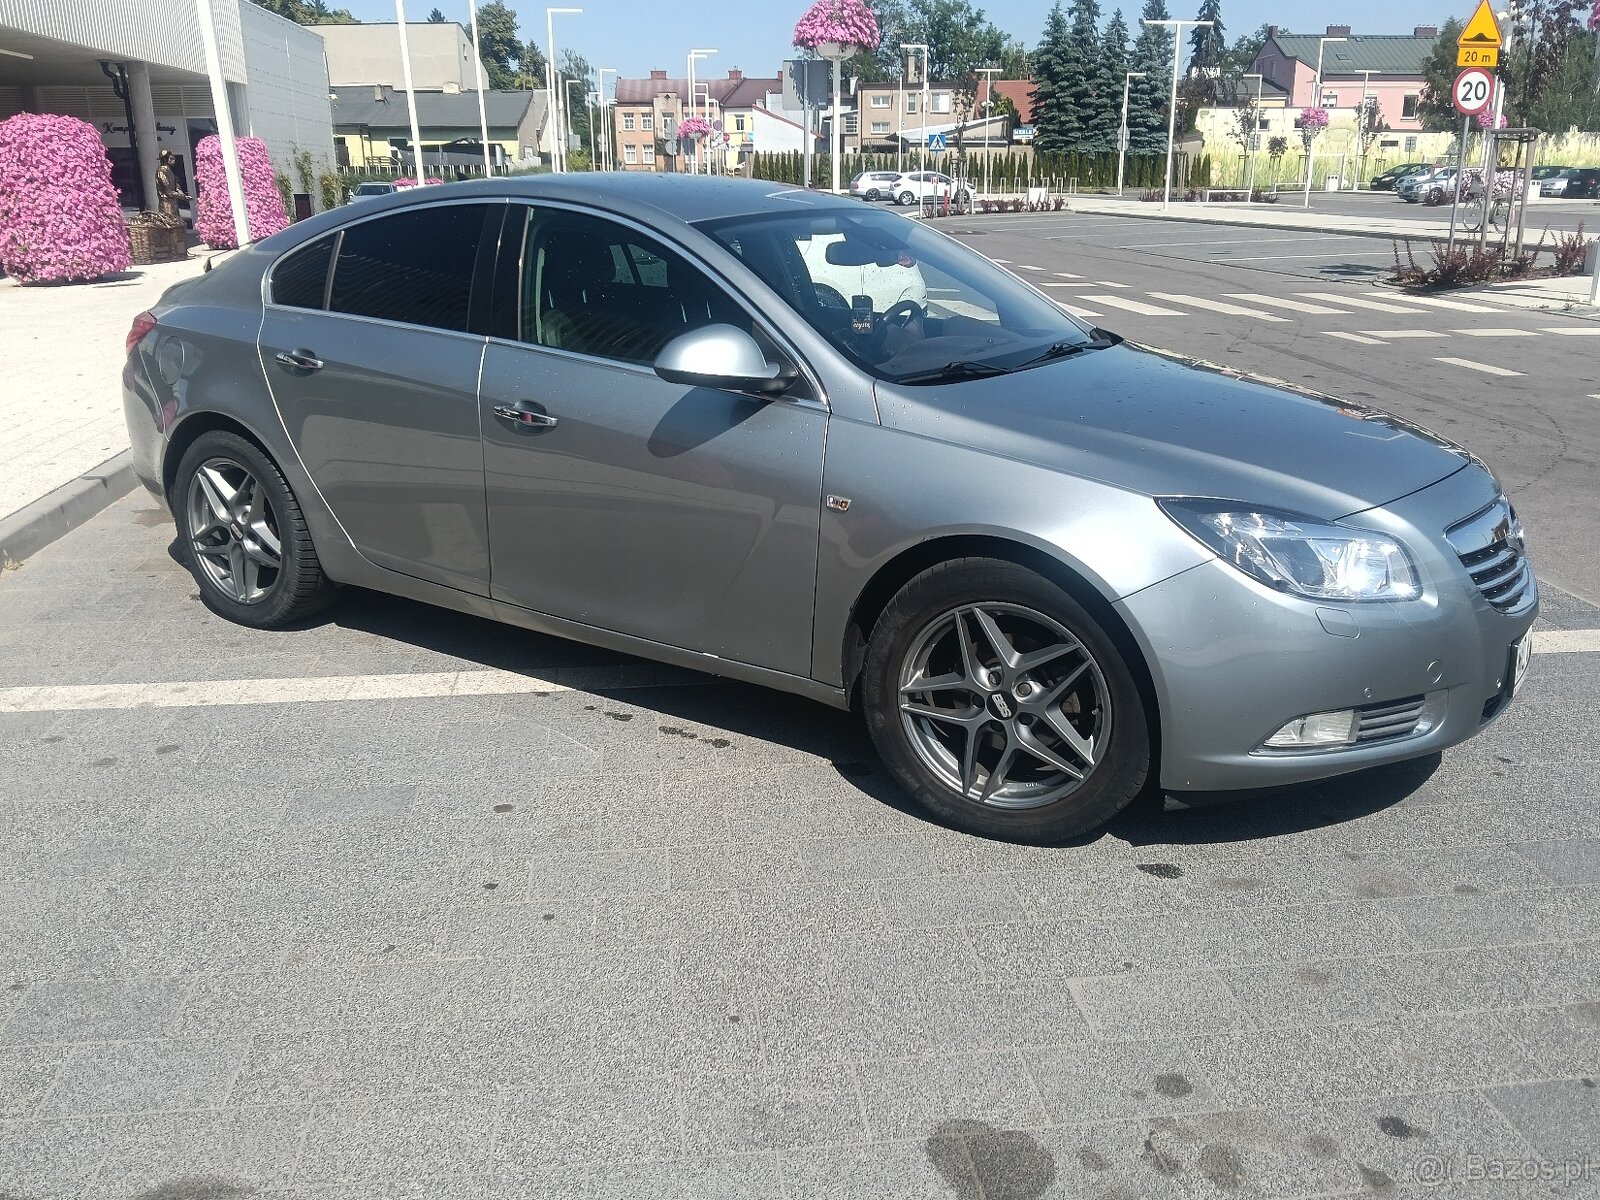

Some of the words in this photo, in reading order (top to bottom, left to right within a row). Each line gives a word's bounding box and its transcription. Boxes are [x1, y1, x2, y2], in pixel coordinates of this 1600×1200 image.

[1464, 51, 1478, 62] 20
[1481, 54, 1491, 63] m
[1461, 81, 1486, 101] 20
[991, 693, 1012, 718] BBS
